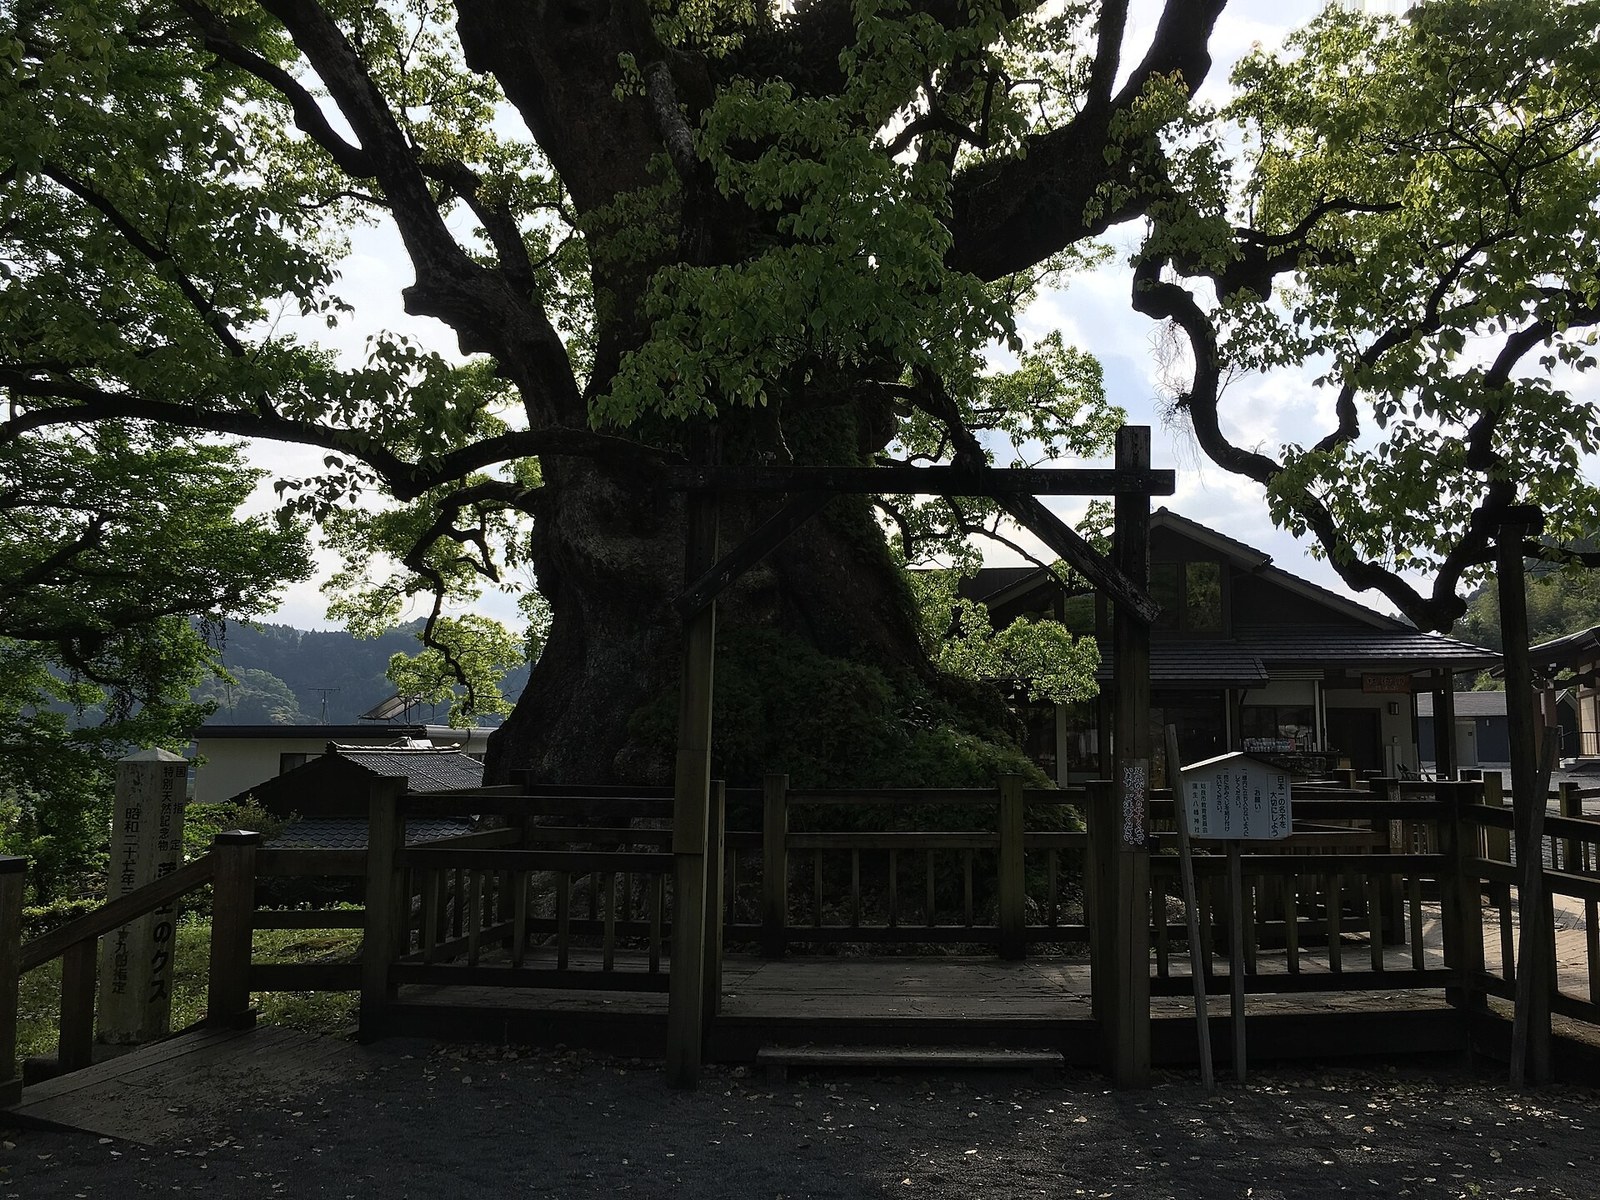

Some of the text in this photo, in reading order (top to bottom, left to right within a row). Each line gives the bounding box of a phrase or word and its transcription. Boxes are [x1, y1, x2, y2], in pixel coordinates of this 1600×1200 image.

[158, 766, 174, 851] 特別天然記念物
[1270, 791, 1279, 837] 大切にしよう
[1277, 775, 1287, 829] 日本一の名木を
[112, 807, 140, 994] 昭和二十七年三十九日指定
